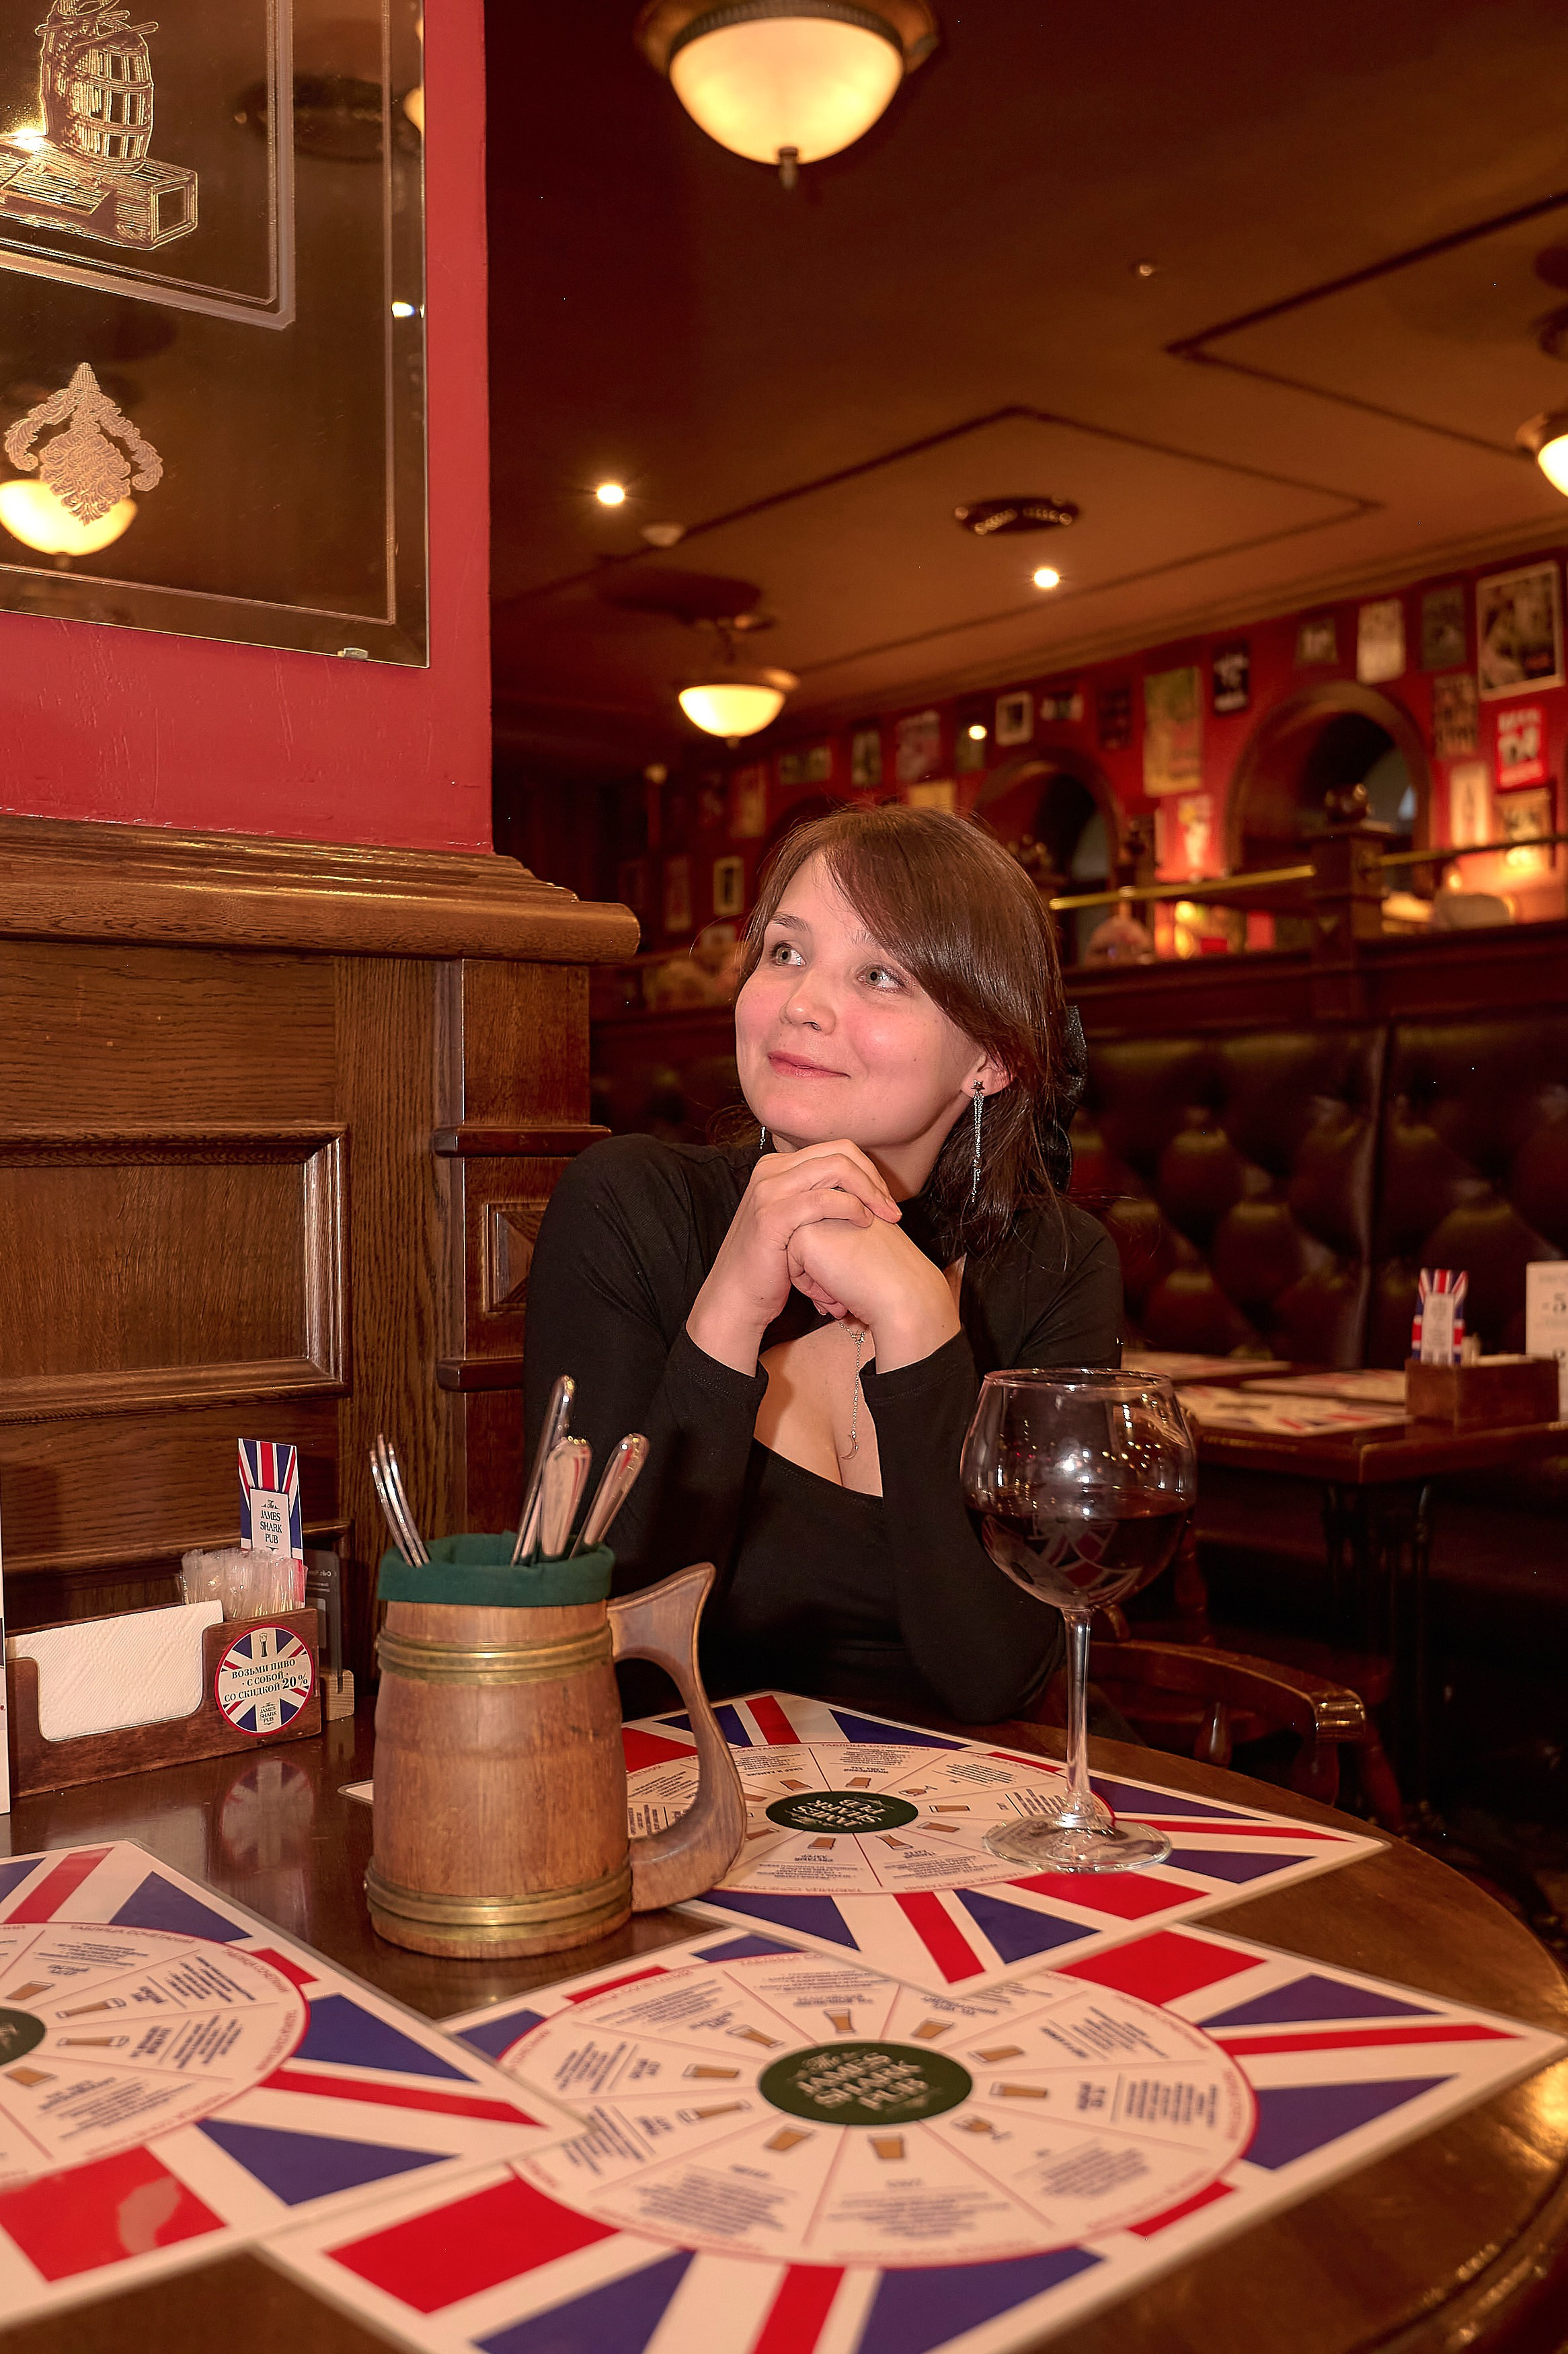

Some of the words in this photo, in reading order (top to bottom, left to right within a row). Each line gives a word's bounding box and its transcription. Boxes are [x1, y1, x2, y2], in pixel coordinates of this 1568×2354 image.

[260, 1510, 280, 1521] JAMES
[260, 1521, 282, 1533] SHARK
[265, 1533, 278, 1544] PUB
[232, 1665, 268, 1679] ВОЗЬМИ
[270, 1659, 296, 1671] ПИВО
[254, 1670, 284, 1685] СОБОЙ
[224, 1694, 236, 1702] СО
[238, 1682, 280, 1700] СКИДКОЙ
[792, 1805, 863, 1827] JAMES
[806, 1799, 882, 1823] SHARK
[839, 1799, 886, 1815] PUB
[797, 2052, 892, 2097] JAMES
[814, 2059, 923, 2109] SHARK
[857, 2077, 929, 2111] PUB
